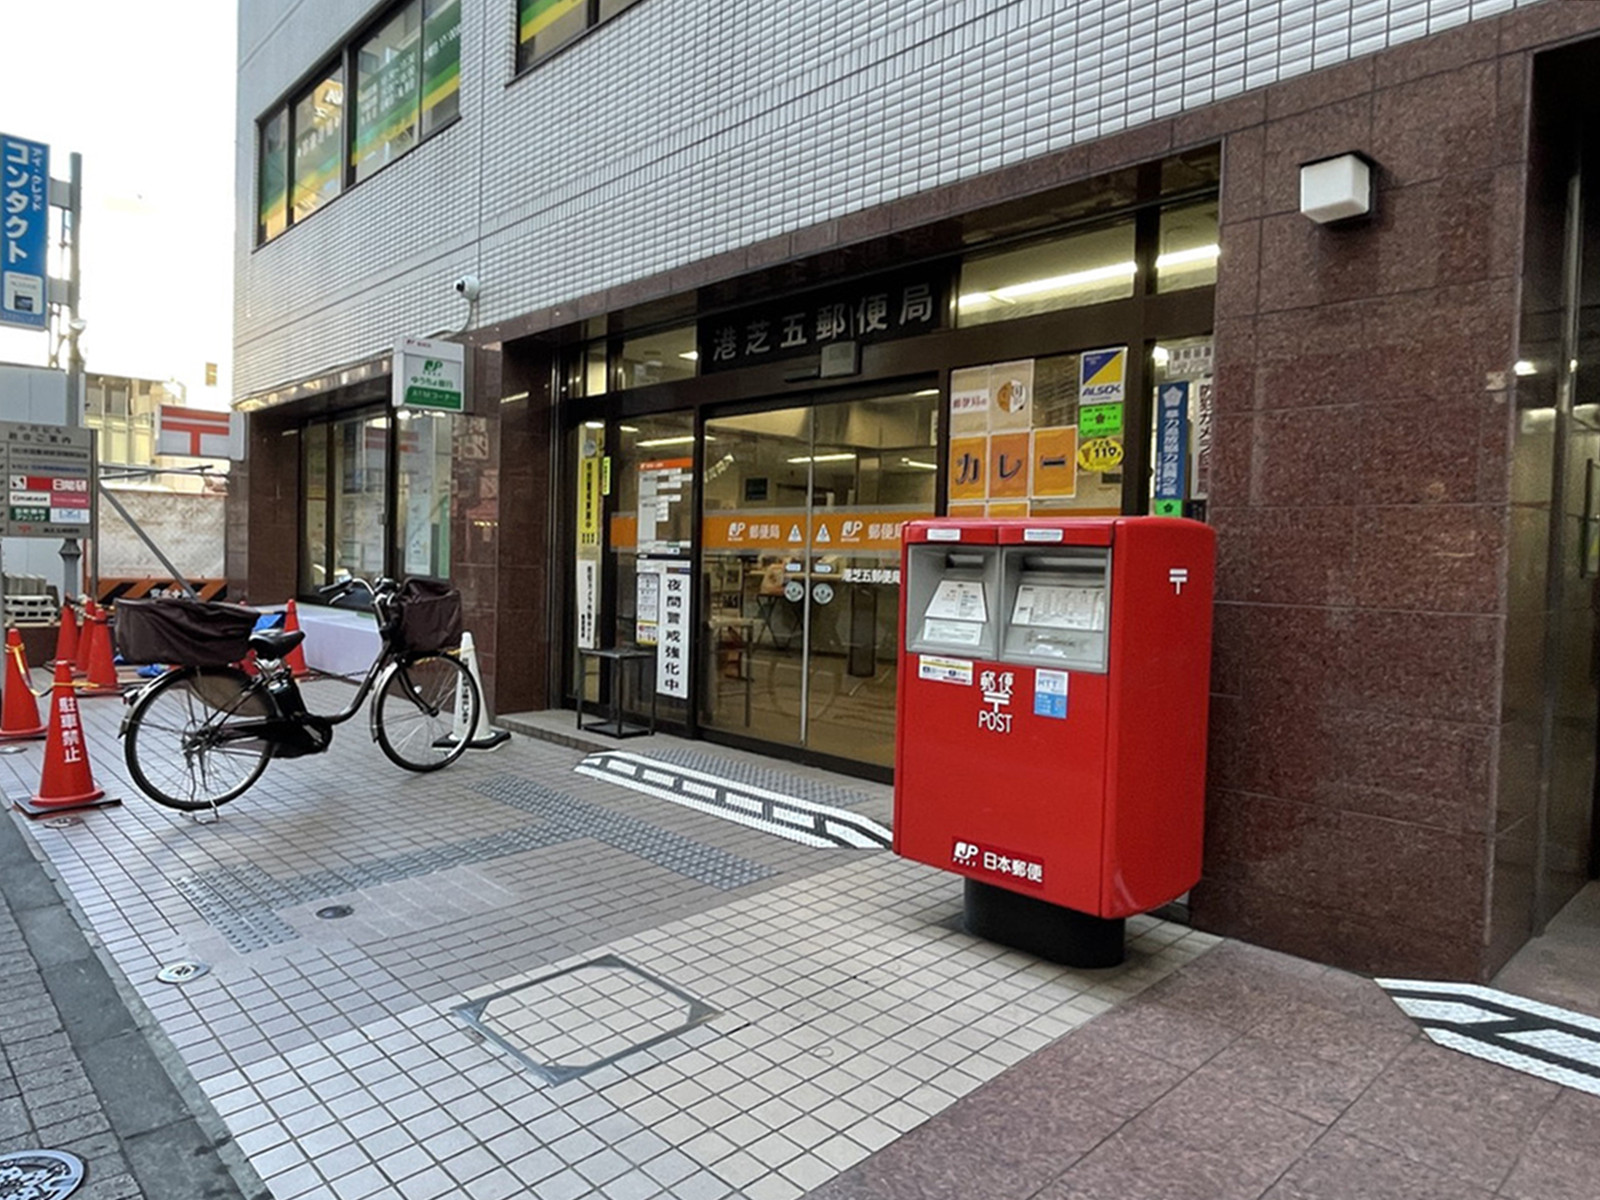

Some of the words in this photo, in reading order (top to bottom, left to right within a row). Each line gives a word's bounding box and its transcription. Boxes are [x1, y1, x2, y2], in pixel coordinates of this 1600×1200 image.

[5, 141, 29, 264] コンタクト
[712, 282, 933, 362] 港芝五郵便局
[1082, 384, 1121, 396] ALSOK
[664, 579, 682, 691] 夜間警戒強化中
[980, 670, 1014, 695] 郵便
[59, 697, 81, 763] 駐車禁止
[978, 710, 1013, 733] POST
[983, 851, 1043, 883] 日本郵便
